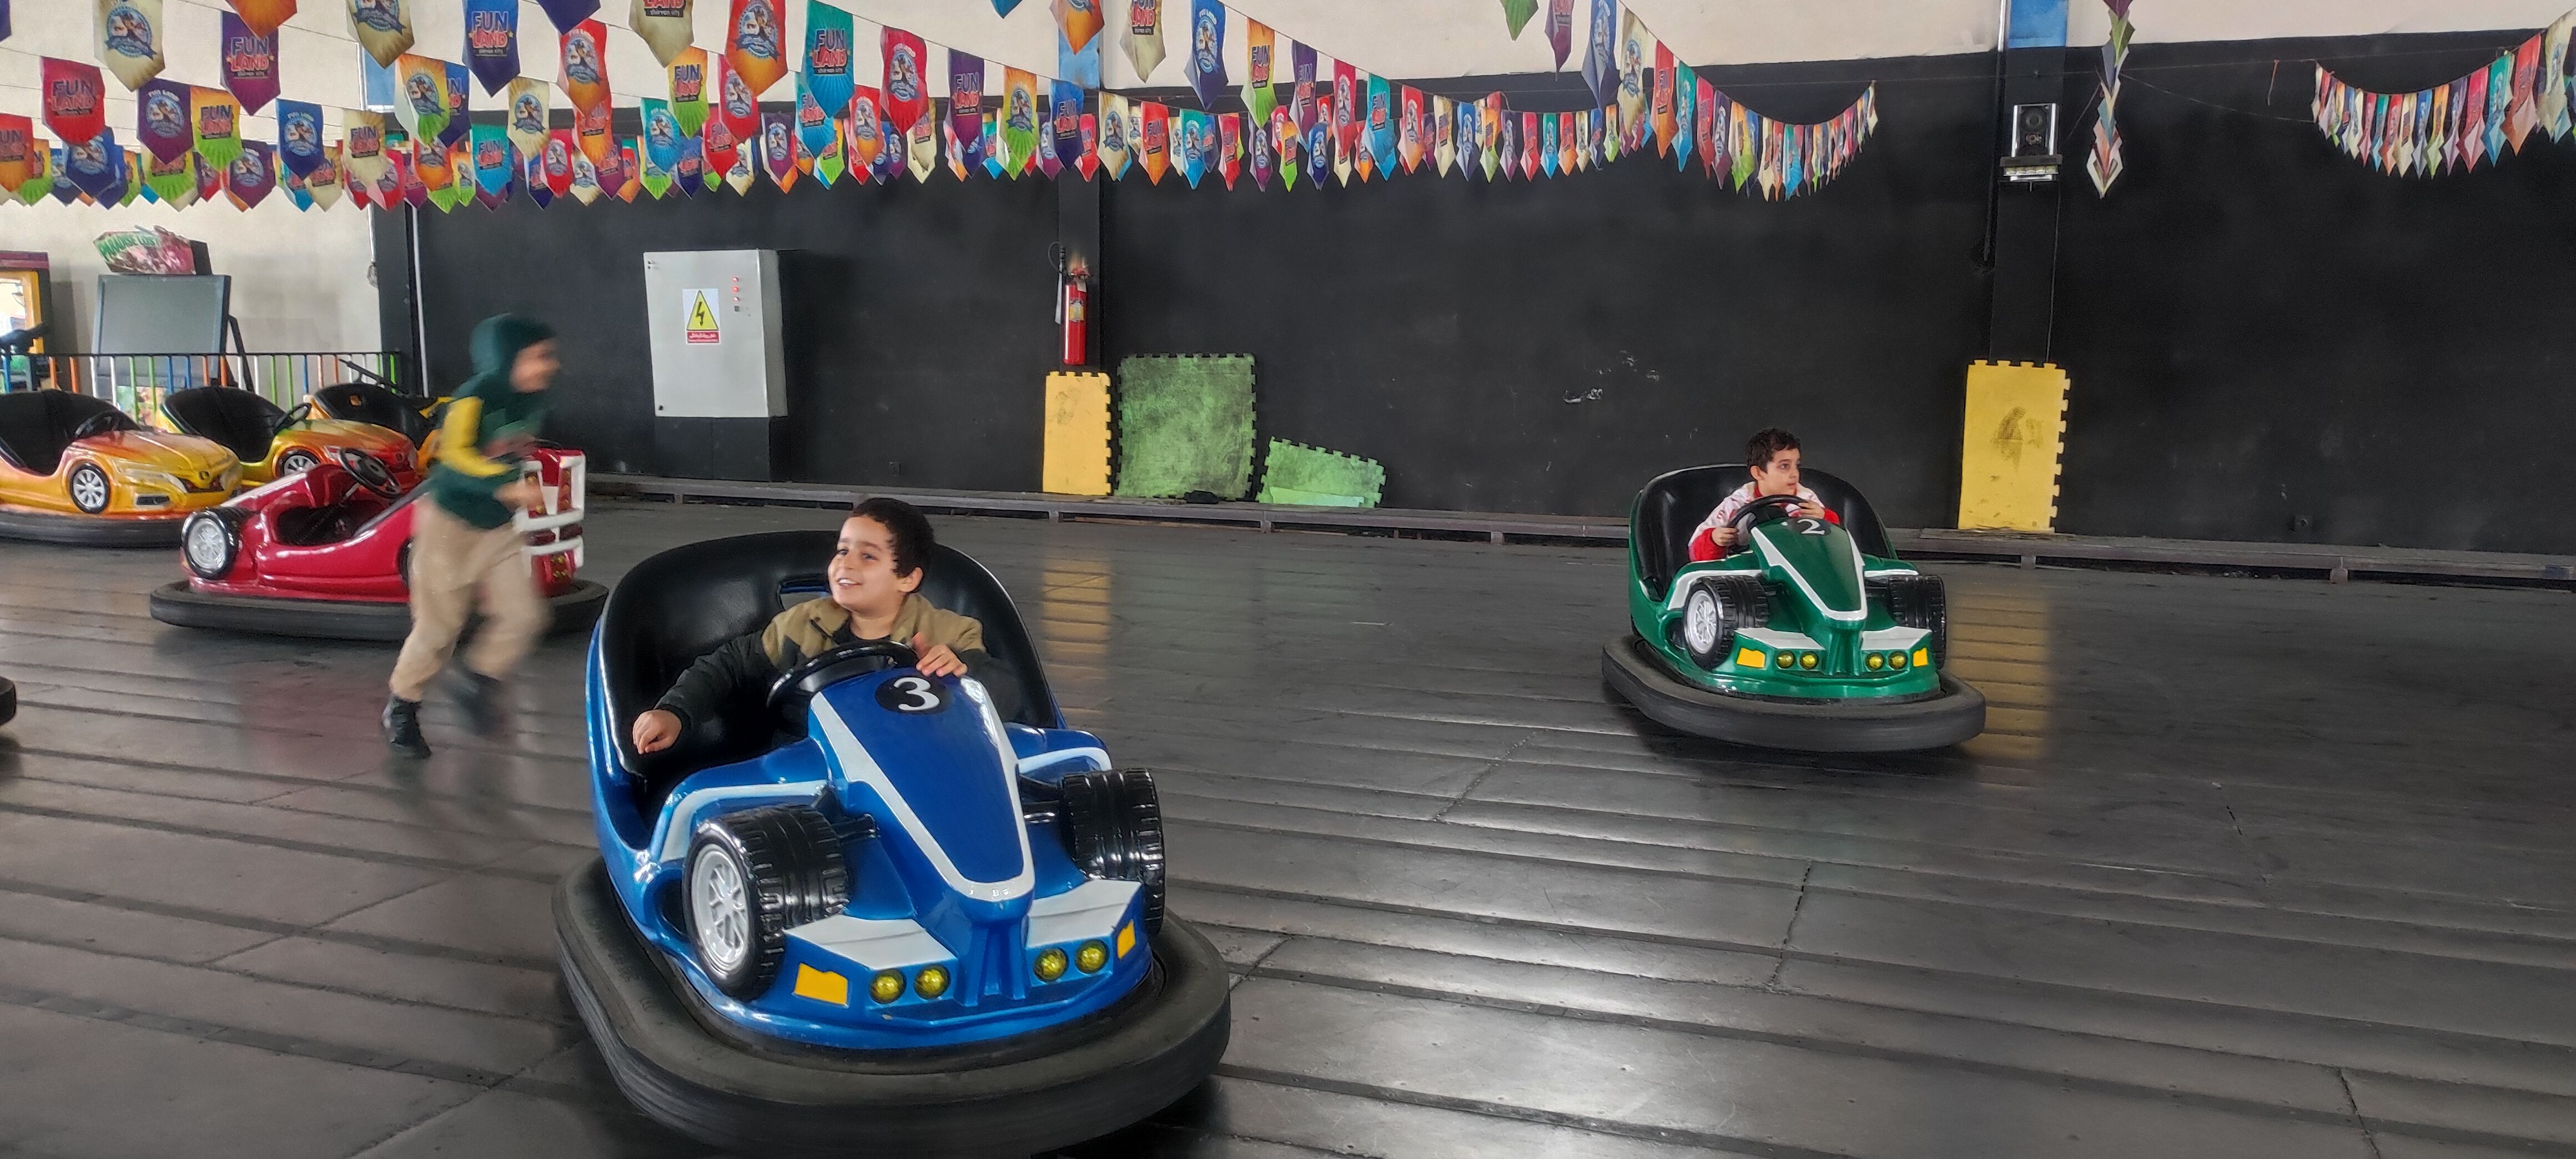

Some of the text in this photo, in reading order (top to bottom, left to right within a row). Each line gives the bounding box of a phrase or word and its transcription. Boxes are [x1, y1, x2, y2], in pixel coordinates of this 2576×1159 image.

[472, 11, 509, 33] FUN
[230, 36, 269, 56] FUN
[472, 28, 508, 48] LAND
[814, 29, 846, 52] FUN
[230, 52, 270, 72] LAND
[812, 46, 847, 67] LAND
[674, 63, 701, 82] FUN
[954, 72, 979, 93] FUN
[53, 79, 94, 97] FUN
[954, 90, 979, 109] LAND
[200, 104, 233, 120] FUN
[0, 129, 23, 143] UN
[350, 125, 378, 142] FUN
[1797, 518, 1825, 535] 2
[893, 677, 940, 710] 3
